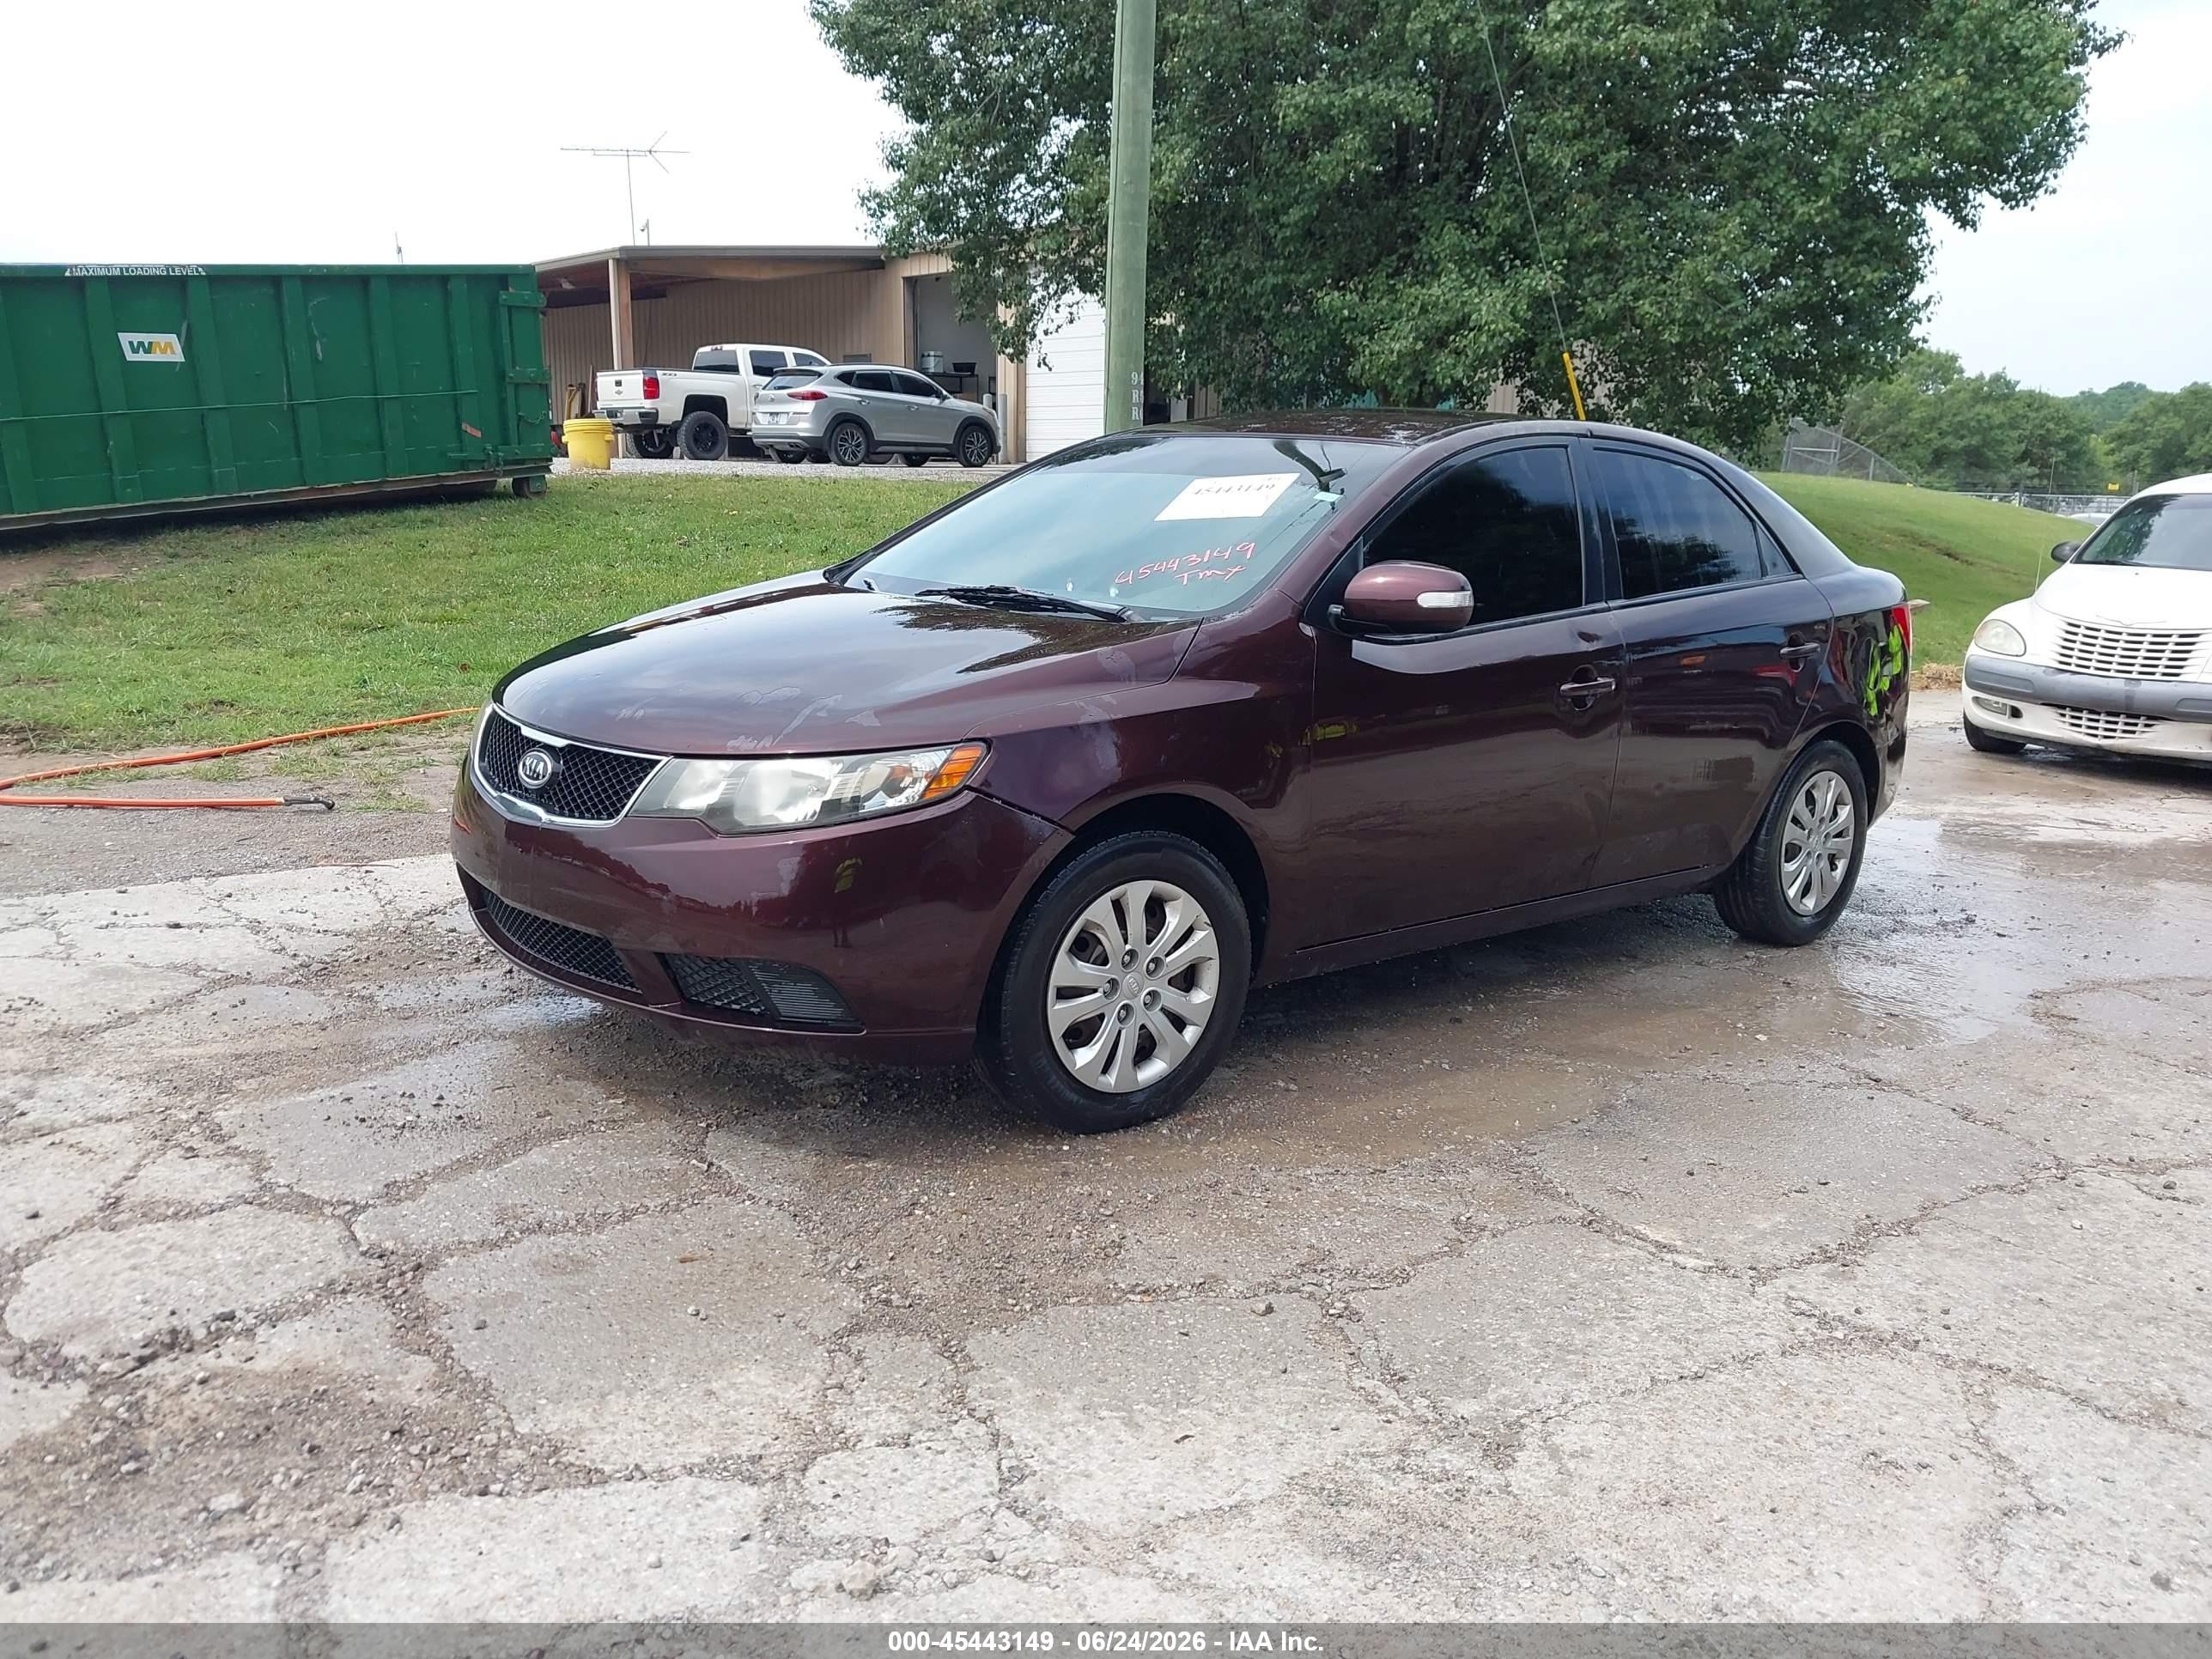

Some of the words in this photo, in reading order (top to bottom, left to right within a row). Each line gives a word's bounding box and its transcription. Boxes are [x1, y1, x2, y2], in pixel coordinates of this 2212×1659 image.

[73, 267, 120, 276] MAXIMUM
[123, 267, 167, 276] LOADING
[169, 267, 198, 276] LEVEL
[128, 341, 176, 354] WM
[1115, 542, 1255, 584] 45443149
[525, 757, 544, 780] KIA
